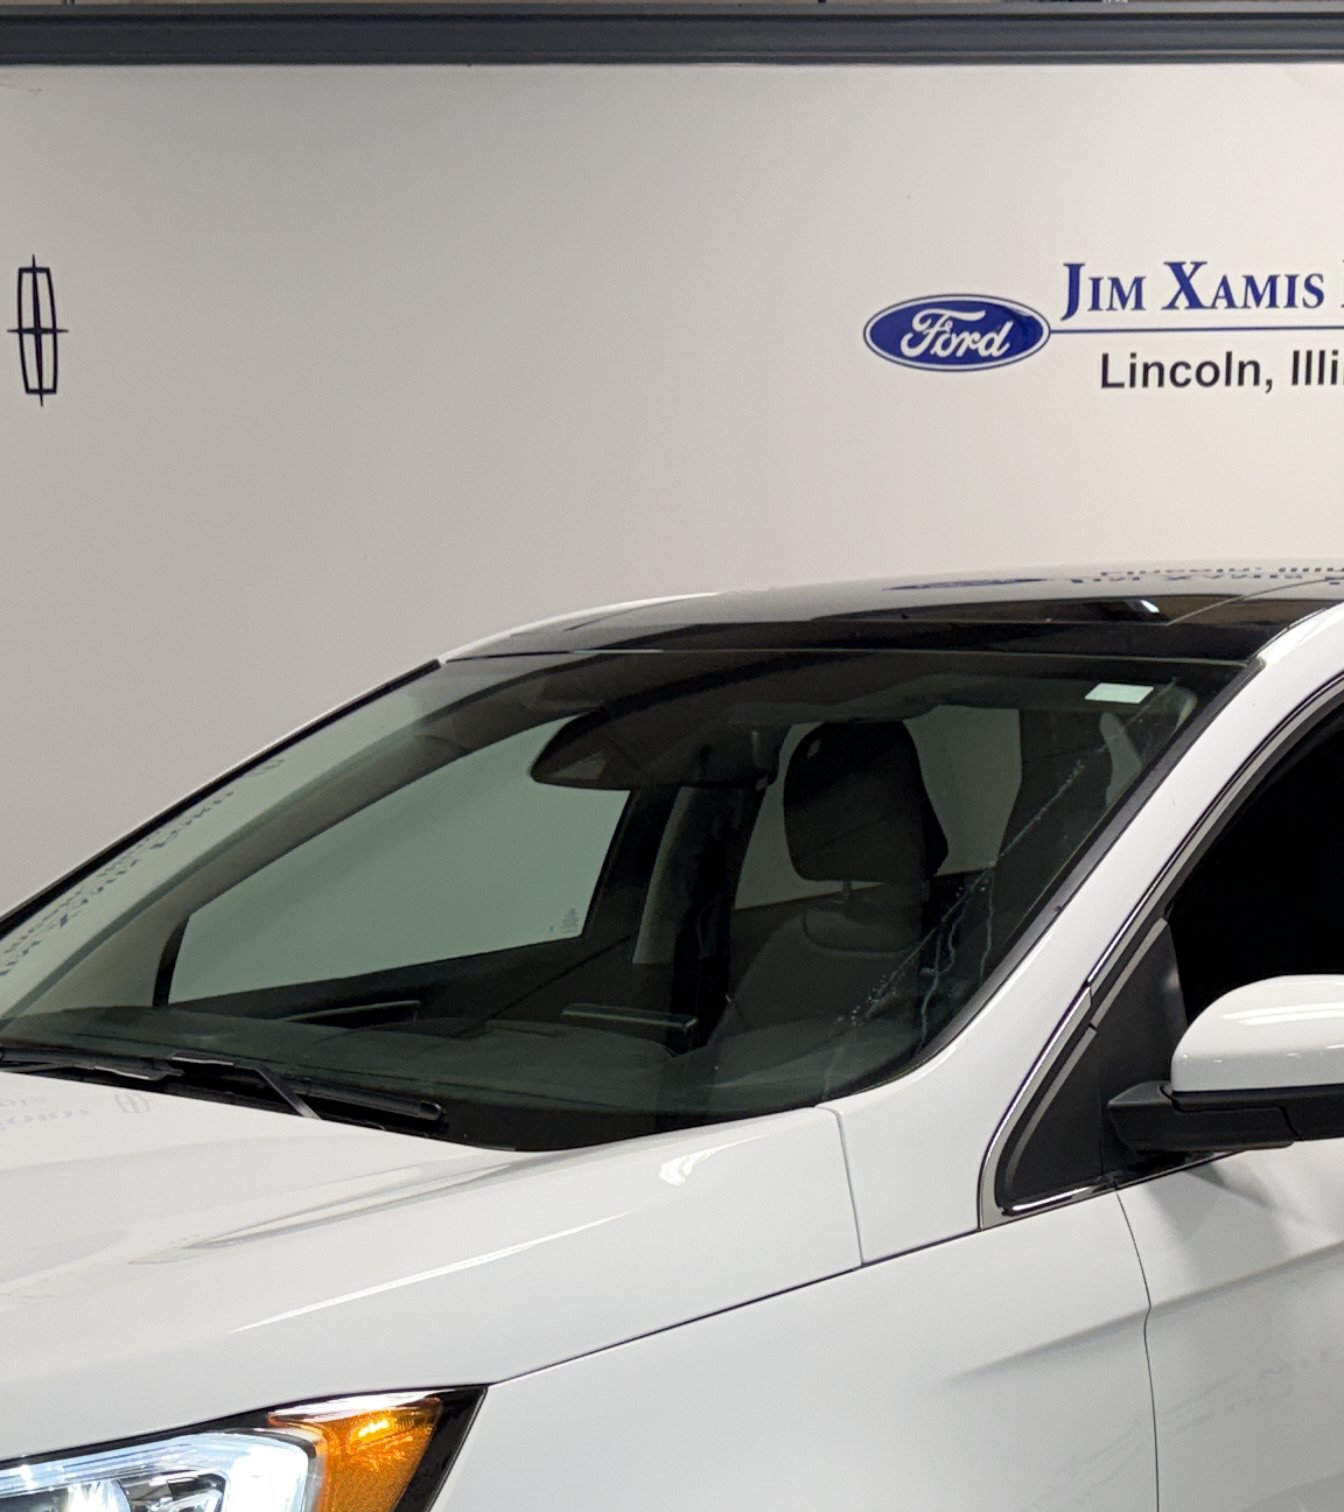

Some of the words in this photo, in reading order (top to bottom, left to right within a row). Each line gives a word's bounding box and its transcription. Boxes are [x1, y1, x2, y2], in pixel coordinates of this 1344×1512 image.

[1060, 262, 1146, 322] JIM
[1161, 261, 1325, 311] XAMIS
[899, 306, 1016, 359] Ford
[1101, 351, 1273, 394] Lincoln,
